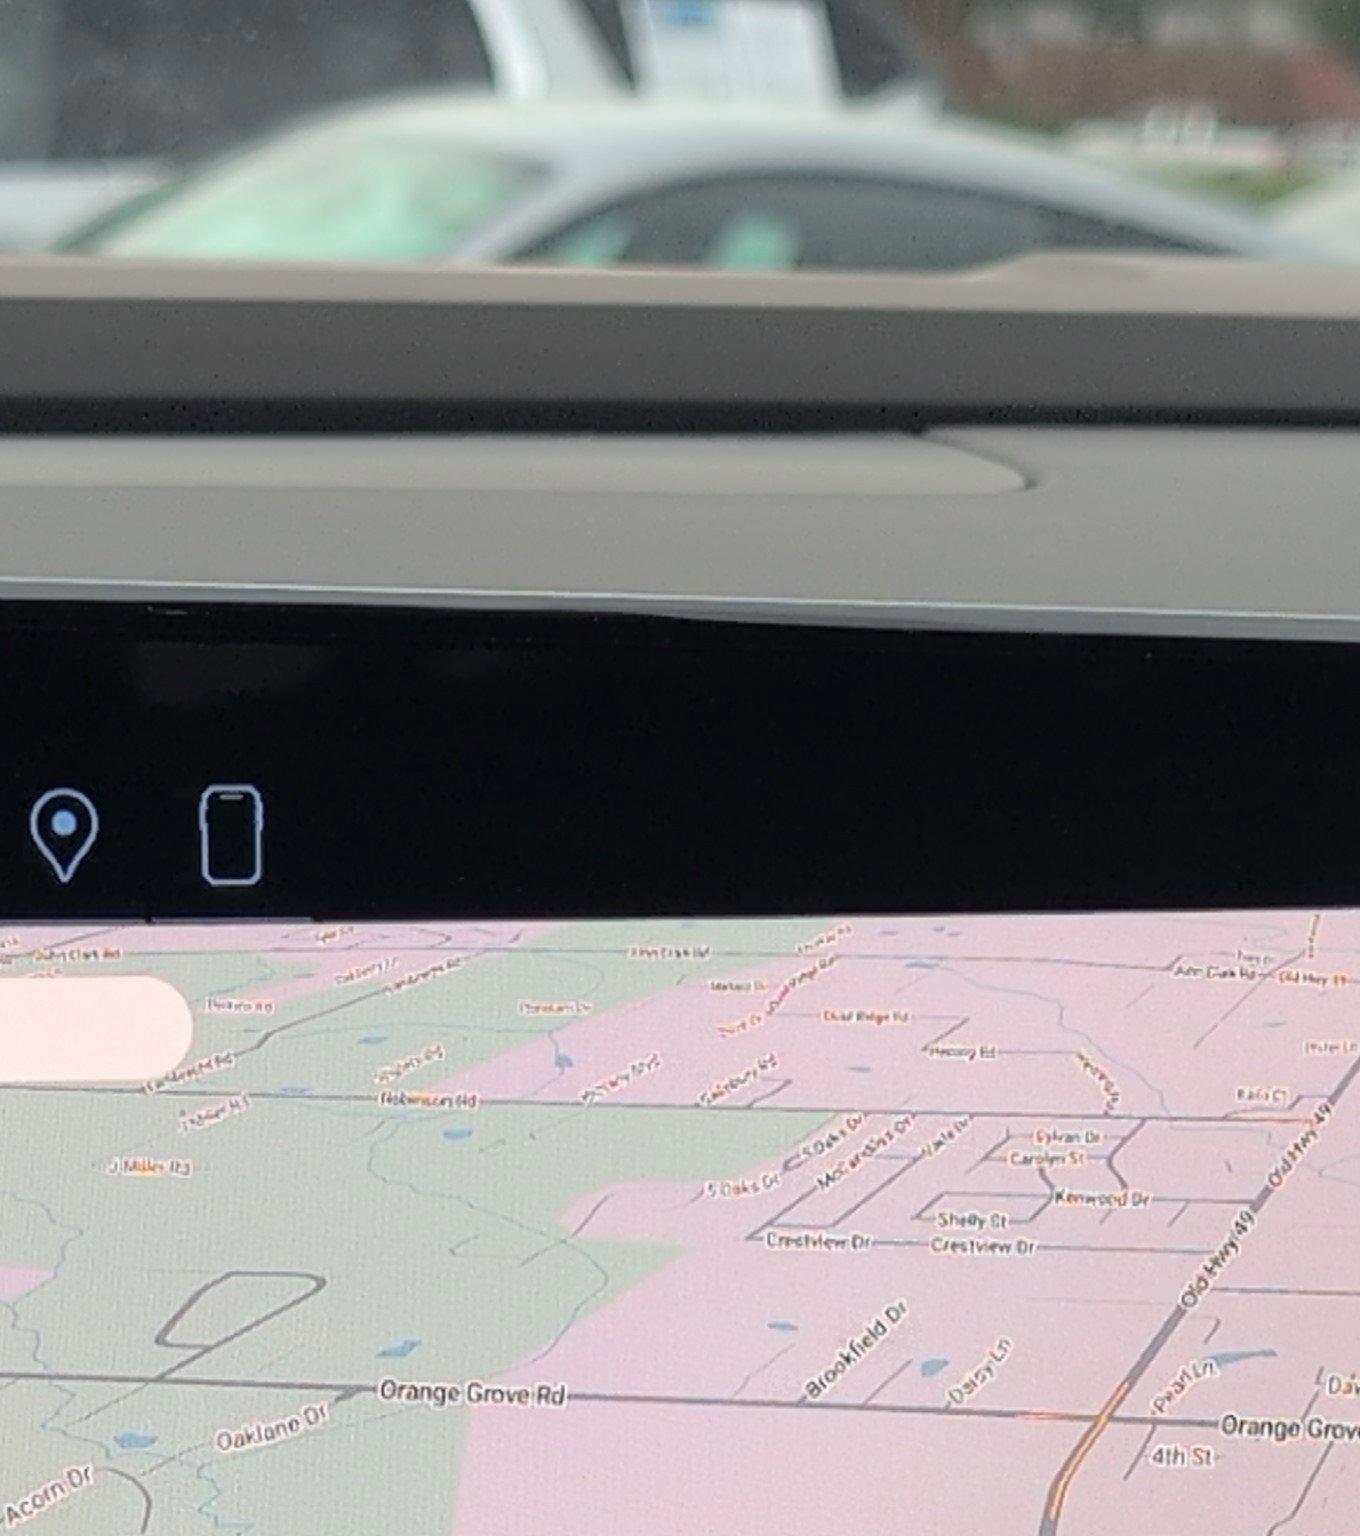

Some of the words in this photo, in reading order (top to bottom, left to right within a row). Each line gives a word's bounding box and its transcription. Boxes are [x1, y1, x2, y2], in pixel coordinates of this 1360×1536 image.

[456, 1092, 480, 1108] Rd
[1034, 1130, 1081, 1146] Sylvan
[1084, 1130, 1101, 1144] Dr
[1267, 1157, 1294, 1189] Old
[1288, 1129, 1322, 1161] Hwy
[1313, 1101, 1333, 1125] 49
[1009, 1151, 1066, 1168] Carolyn
[1069, 1150, 1086, 1165] St
[720, 1180, 761, 1198] Oaks
[762, 1172, 780, 1188] Dr
[1053, 1187, 1128, 1207] Kenwood
[1131, 1191, 1151, 1208] Dr
[937, 1211, 987, 1231] Shelly
[989, 1213, 1008, 1230] St
[766, 1231, 848, 1250] Crestview
[851, 1232, 872, 1250] Dr
[930, 1236, 1013, 1255] Crestview
[1016, 1239, 1037, 1255] Dr
[1181, 1275, 1210, 1309] Old
[1202, 1238, 1241, 1279] Hwy
[1233, 1210, 1256, 1237] 49
[804, 1318, 889, 1400] Brookfield
[884, 1299, 909, 1325] Dr
[947, 1358, 997, 1405] Daisy
[993, 1338, 1012, 1363] Ln
[380, 1380, 460, 1407] Orange
[467, 1382, 531, 1406] Grove
[540, 1384, 566, 1407] Rd
[1154, 1371, 1194, 1414] Pearl
[1192, 1360, 1217, 1381] Ln
[216, 1416, 301, 1453] Oaklane
[303, 1404, 329, 1427] Dr
[1221, 1413, 1302, 1443] Orange
[1151, 1447, 1186, 1466] 4th
[1191, 1447, 1214, 1466] St
[3, 1476, 66, 1527] Acorn
[65, 1465, 94, 1490] Dr
